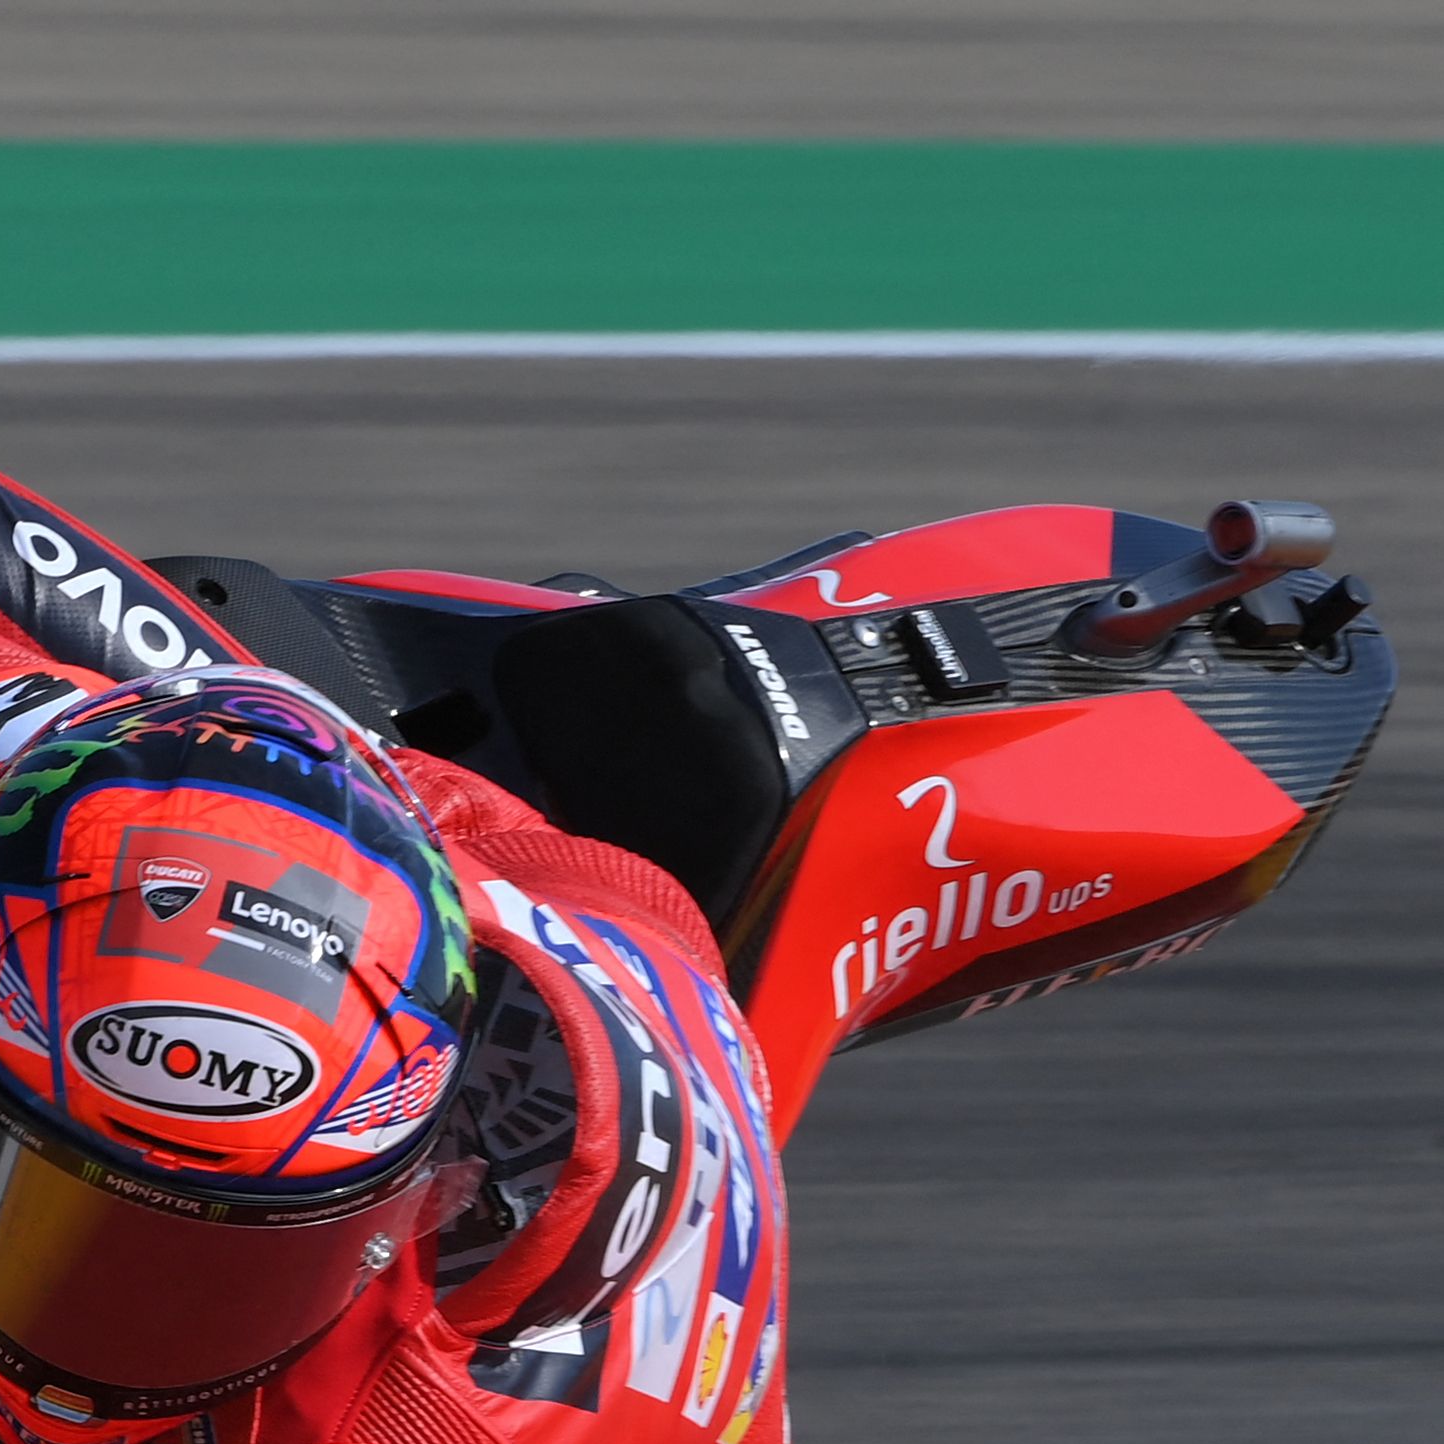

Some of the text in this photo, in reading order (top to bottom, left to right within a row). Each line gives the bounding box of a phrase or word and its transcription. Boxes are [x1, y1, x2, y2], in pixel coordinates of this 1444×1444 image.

[12, 519, 213, 672] ovo
[723, 624, 811, 740] DUCATI
[144, 863, 204, 883] DUCATI
[231, 890, 345, 957] Lenovo
[831, 870, 1044, 1021] riello
[1048, 872, 1114, 915] ups
[94, 1015, 296, 1108] SUOMY
